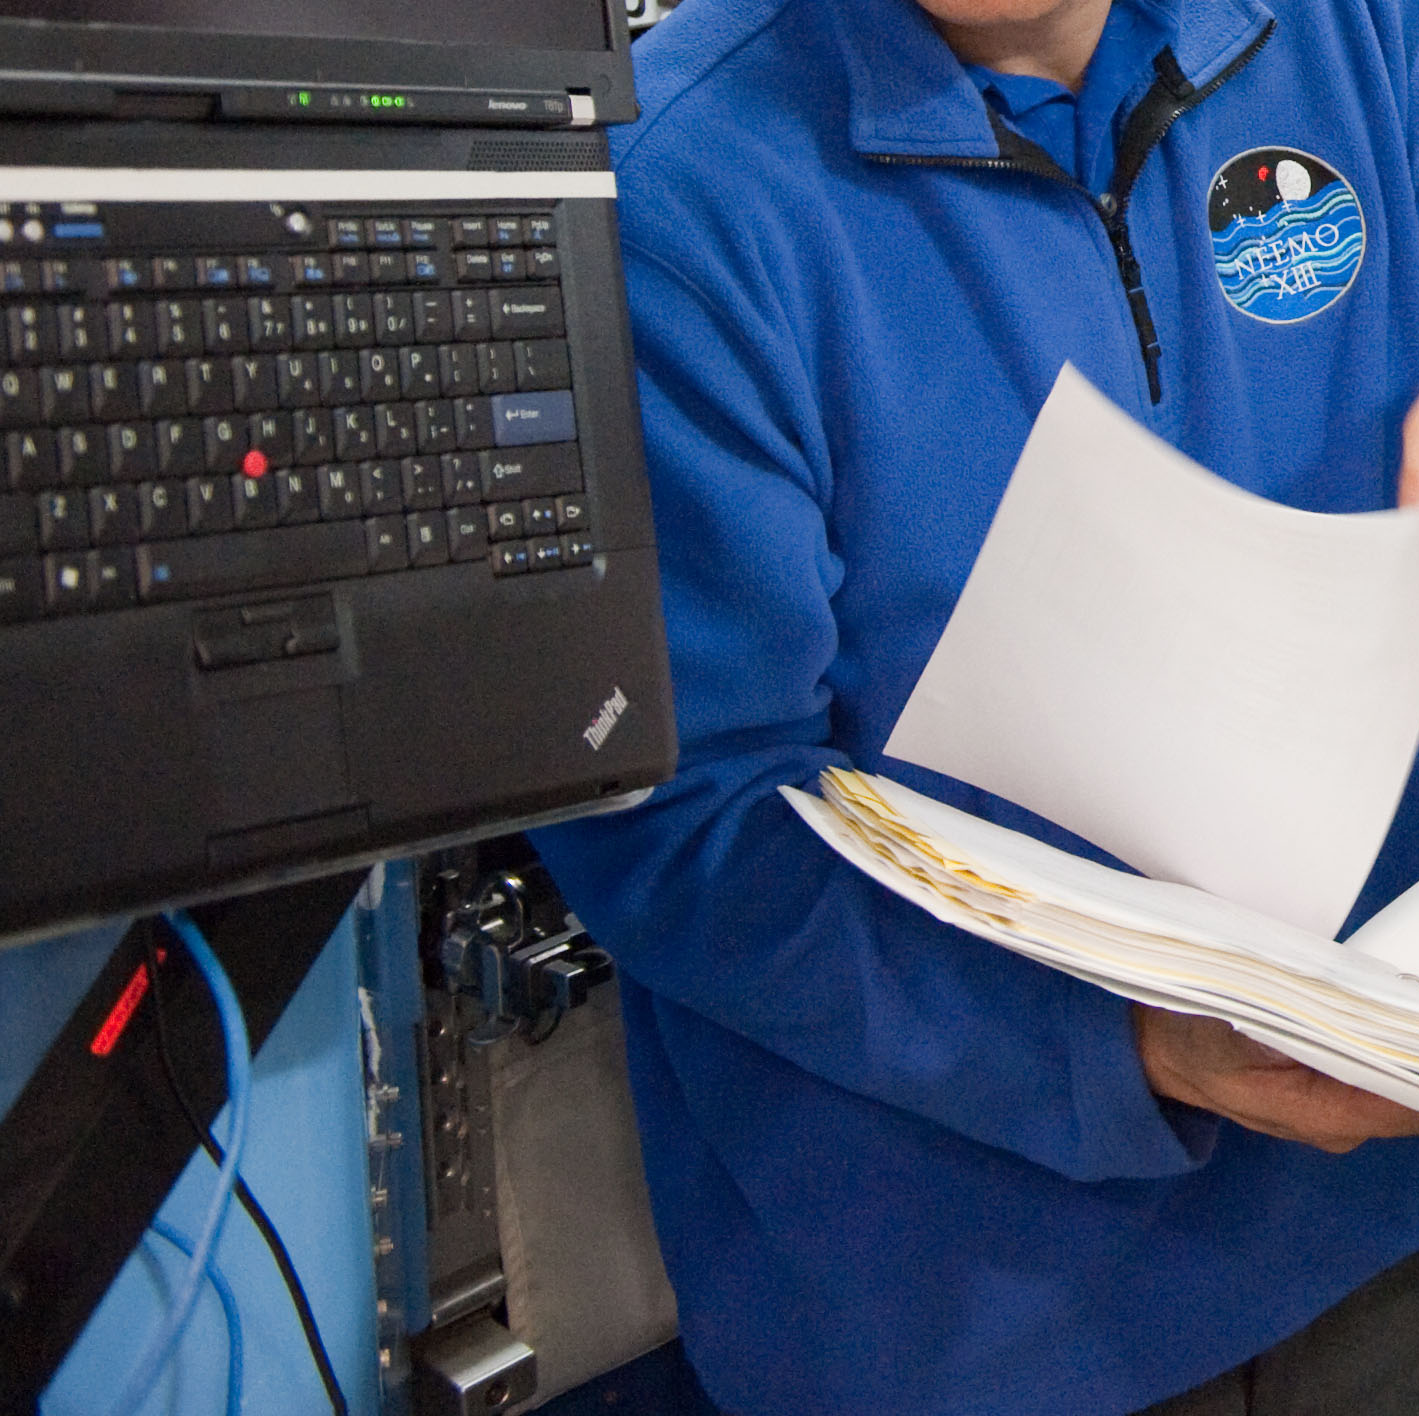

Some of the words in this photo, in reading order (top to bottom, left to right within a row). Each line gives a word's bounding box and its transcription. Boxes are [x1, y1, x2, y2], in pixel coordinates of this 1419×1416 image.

[488, 98, 527, 111] lenovo
[1234, 223, 1339, 280] NEEMO
[1270, 261, 1321, 300] XIII
[411, 352, 421, 369] P
[262, 419, 276, 437] H
[346, 413, 359, 429] K
[288, 476, 302, 493] N
[330, 471, 344, 487] M
[583, 685, 628, 752] ThinkPad
